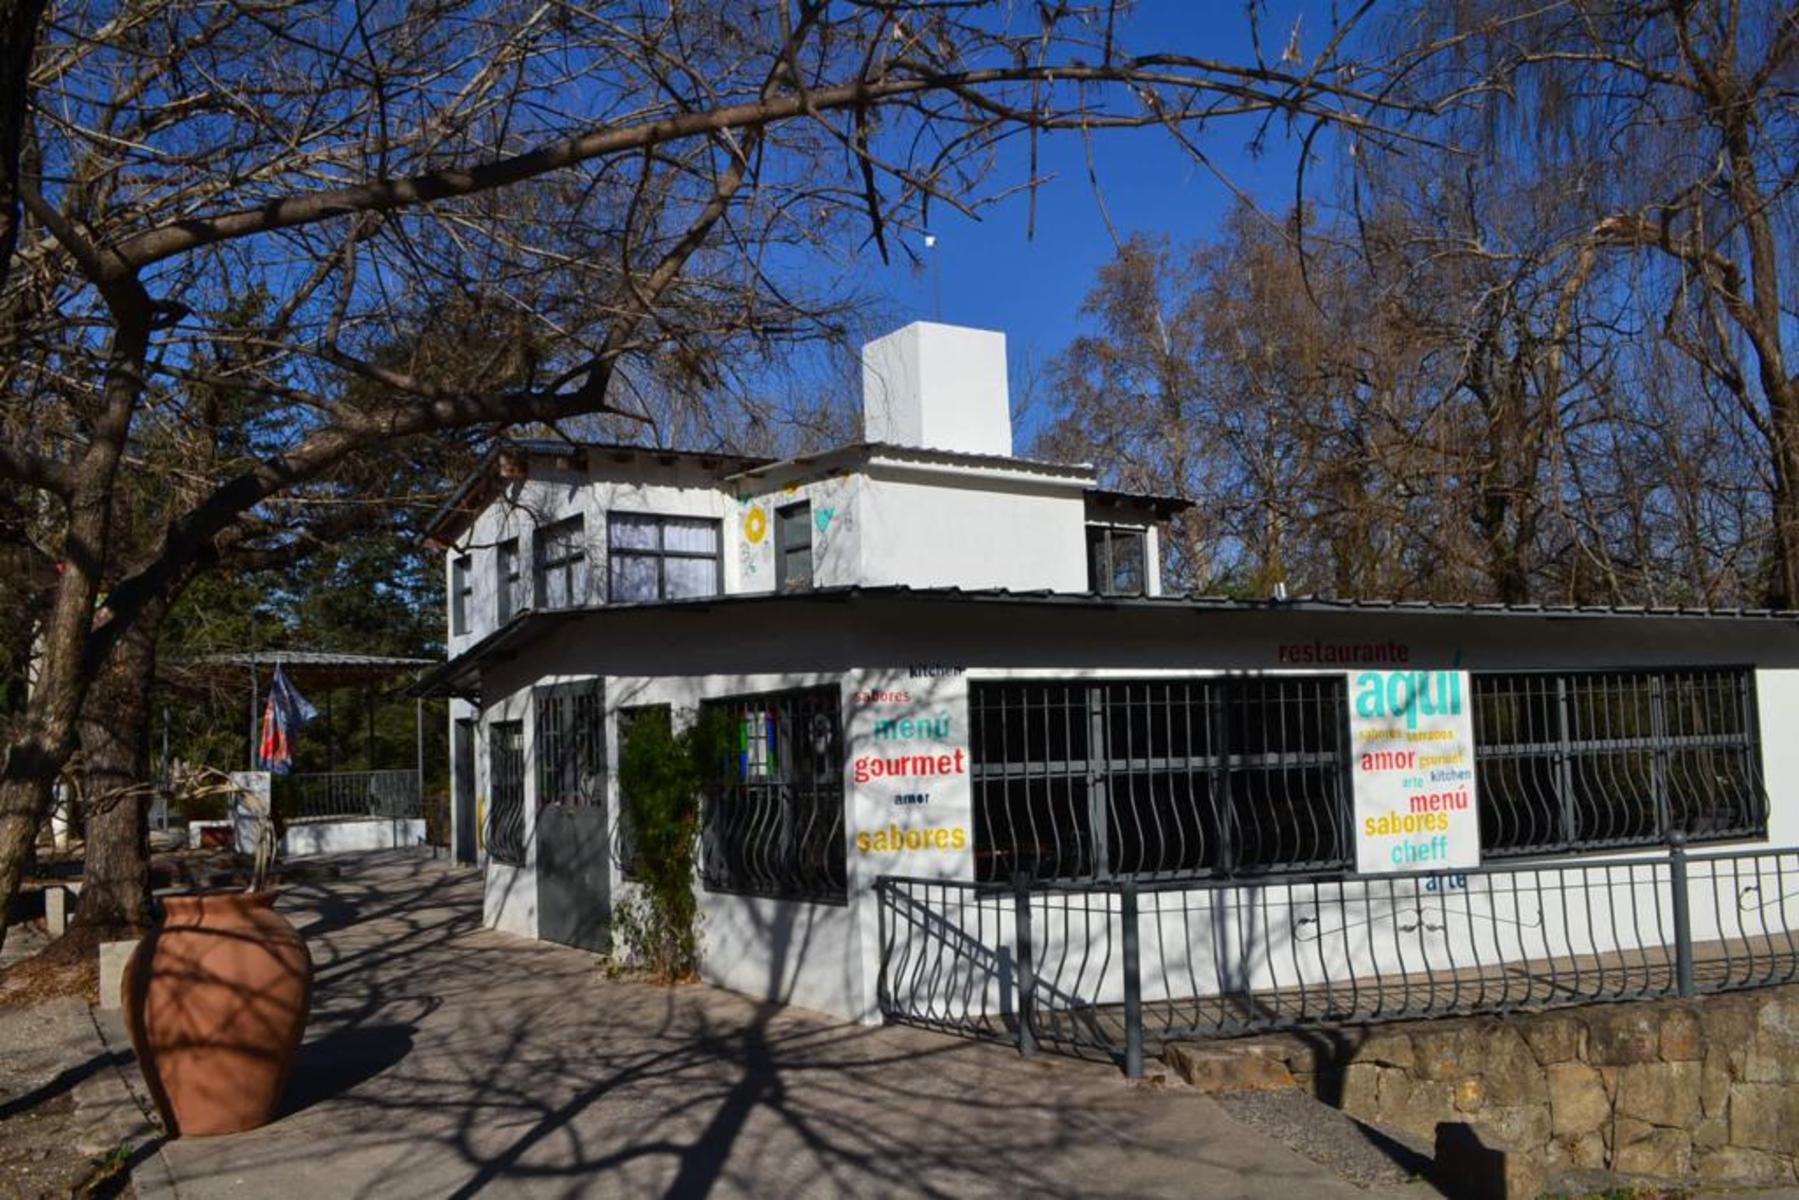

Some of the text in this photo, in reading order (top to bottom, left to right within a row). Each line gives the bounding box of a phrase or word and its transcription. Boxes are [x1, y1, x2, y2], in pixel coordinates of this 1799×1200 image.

[1278, 640, 1409, 663] restaurante
[909, 663, 962, 679] kitchen
[854, 688, 912, 704] sabores
[1356, 649, 1462, 729] aquí
[872, 708, 950, 740] menú
[854, 747, 965, 783] gourmet
[1361, 751, 1416, 770] amor
[1430, 768, 1472, 782] kitchen
[893, 792, 930, 806] amor
[1409, 785, 1468, 813] menú
[1365, 811, 1448, 836] sabores
[856, 823, 967, 854] sabores
[1390, 835, 1448, 864] cheff
[1424, 872, 1466, 891] ate
